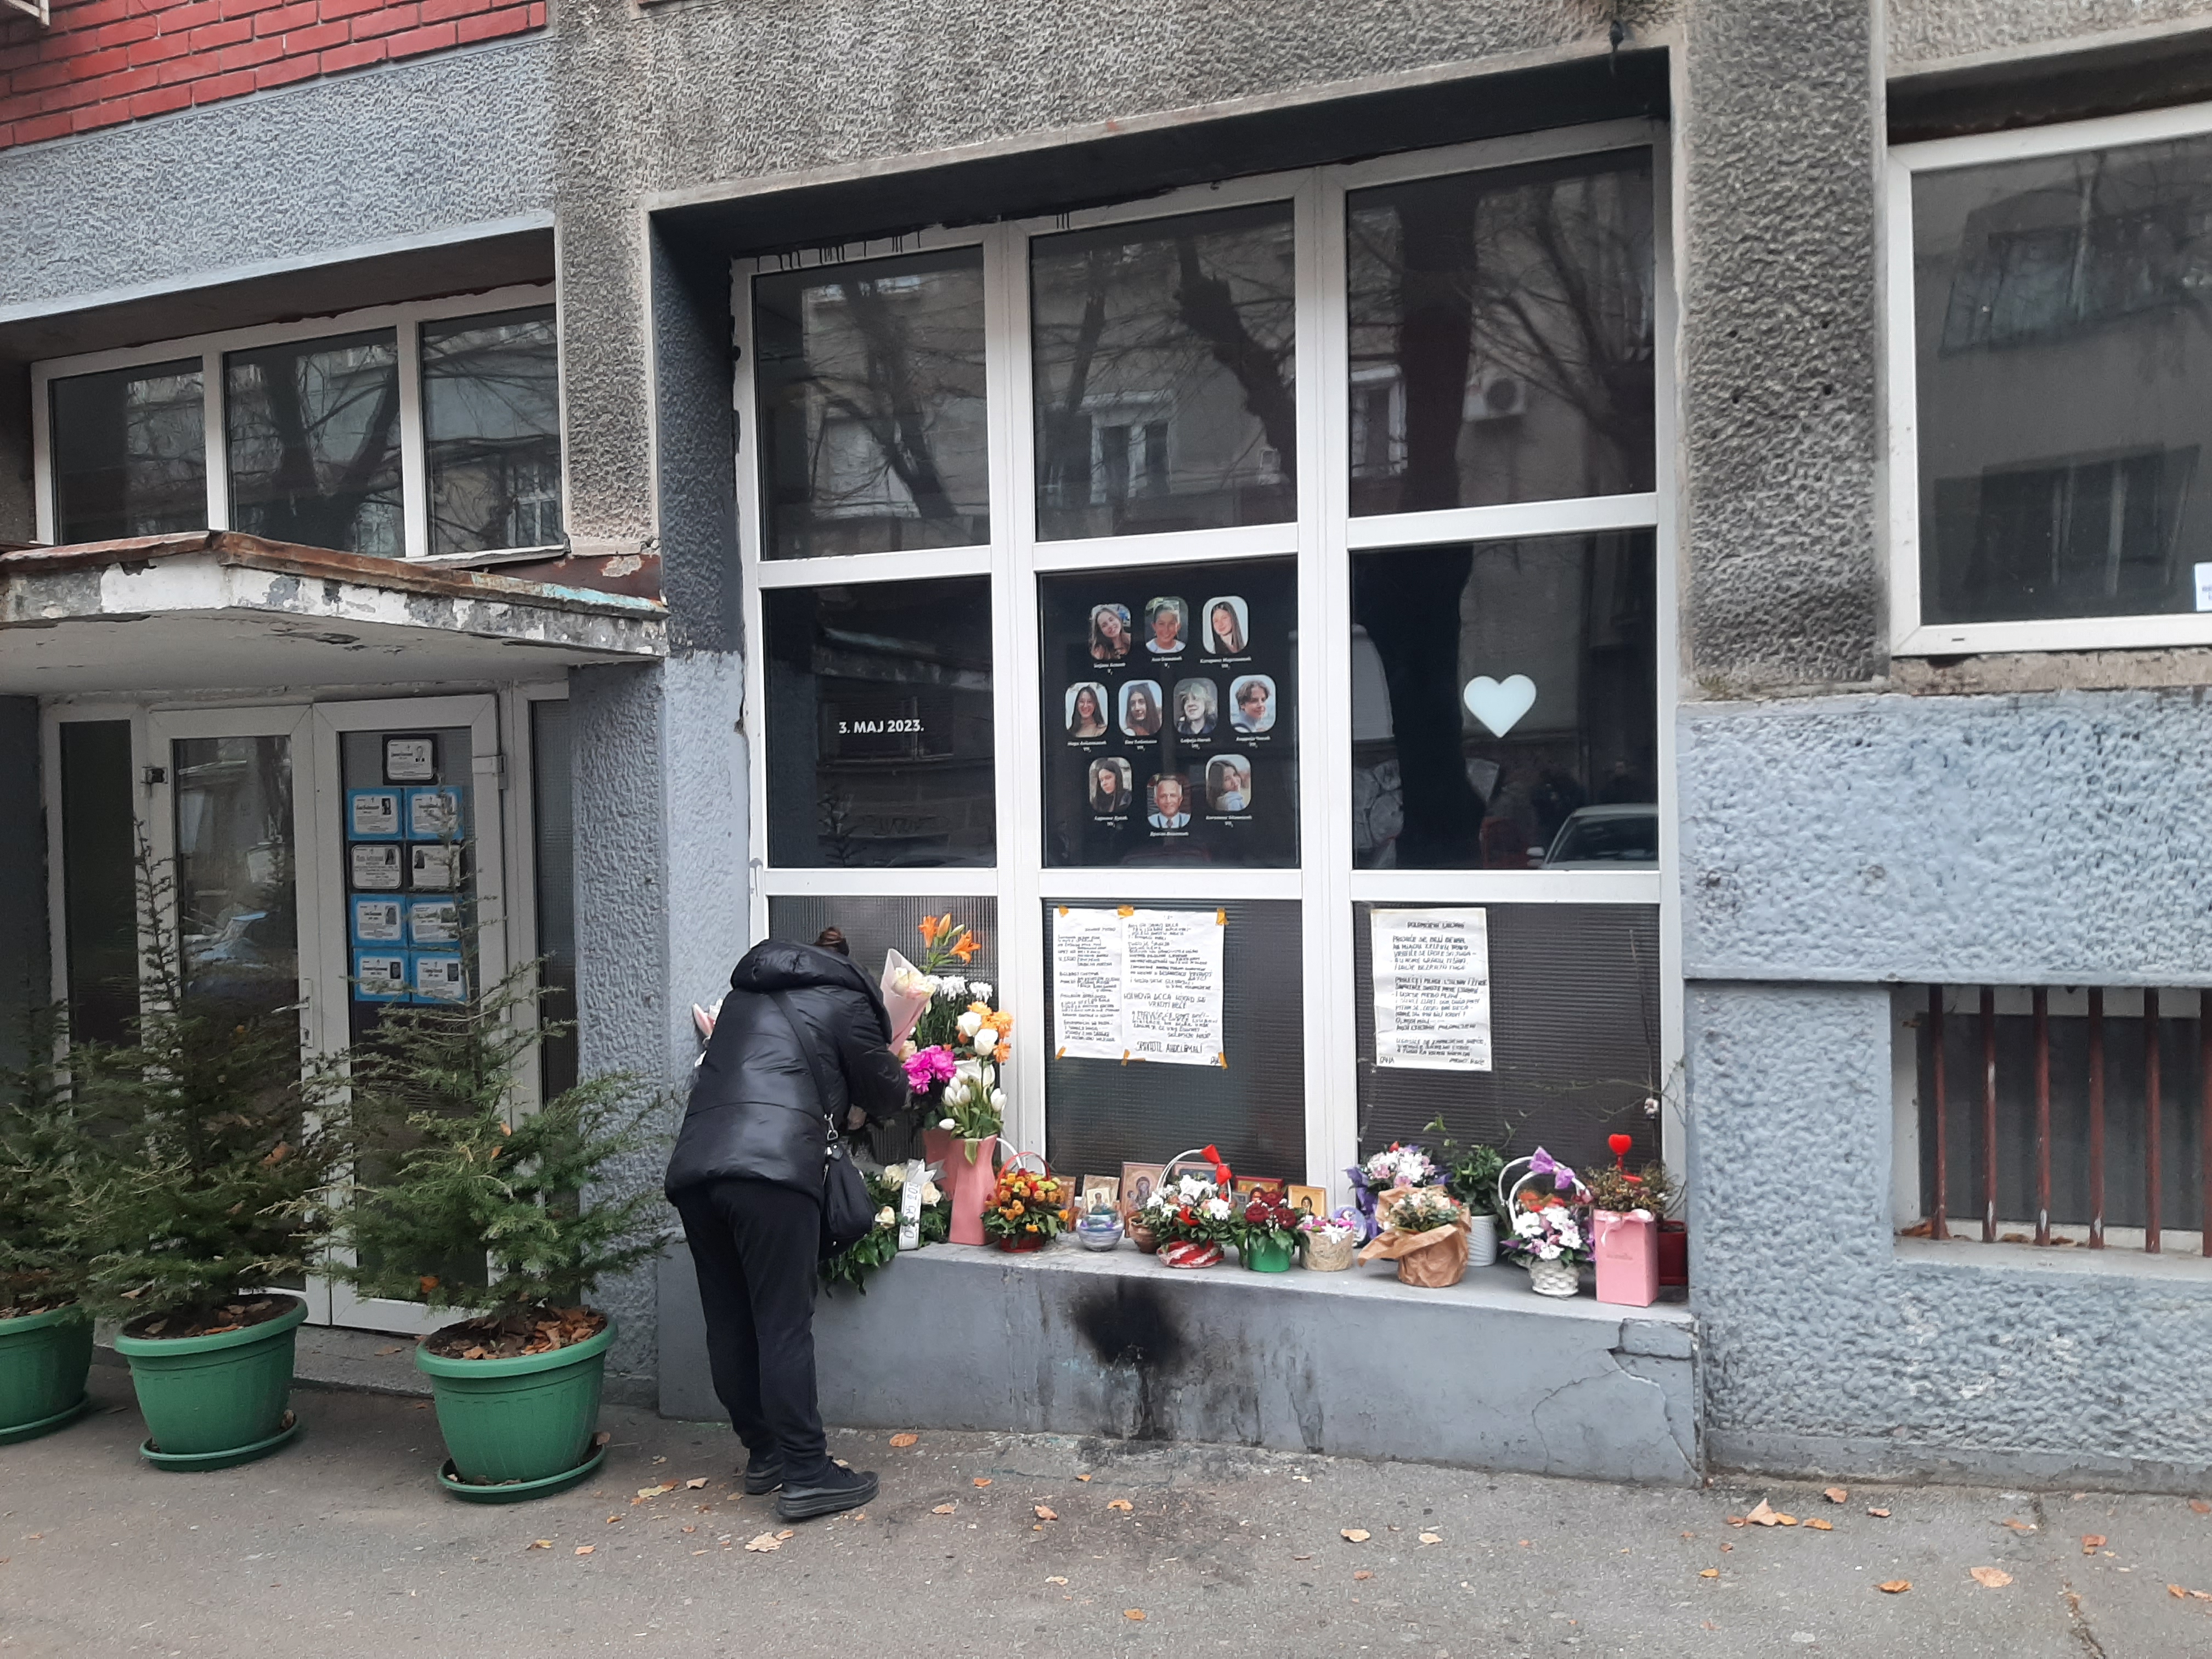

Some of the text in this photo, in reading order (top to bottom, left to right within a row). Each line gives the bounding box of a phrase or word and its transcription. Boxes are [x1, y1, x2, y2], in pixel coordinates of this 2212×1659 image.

[839, 719, 924, 734] 3. MAJ 2023.
